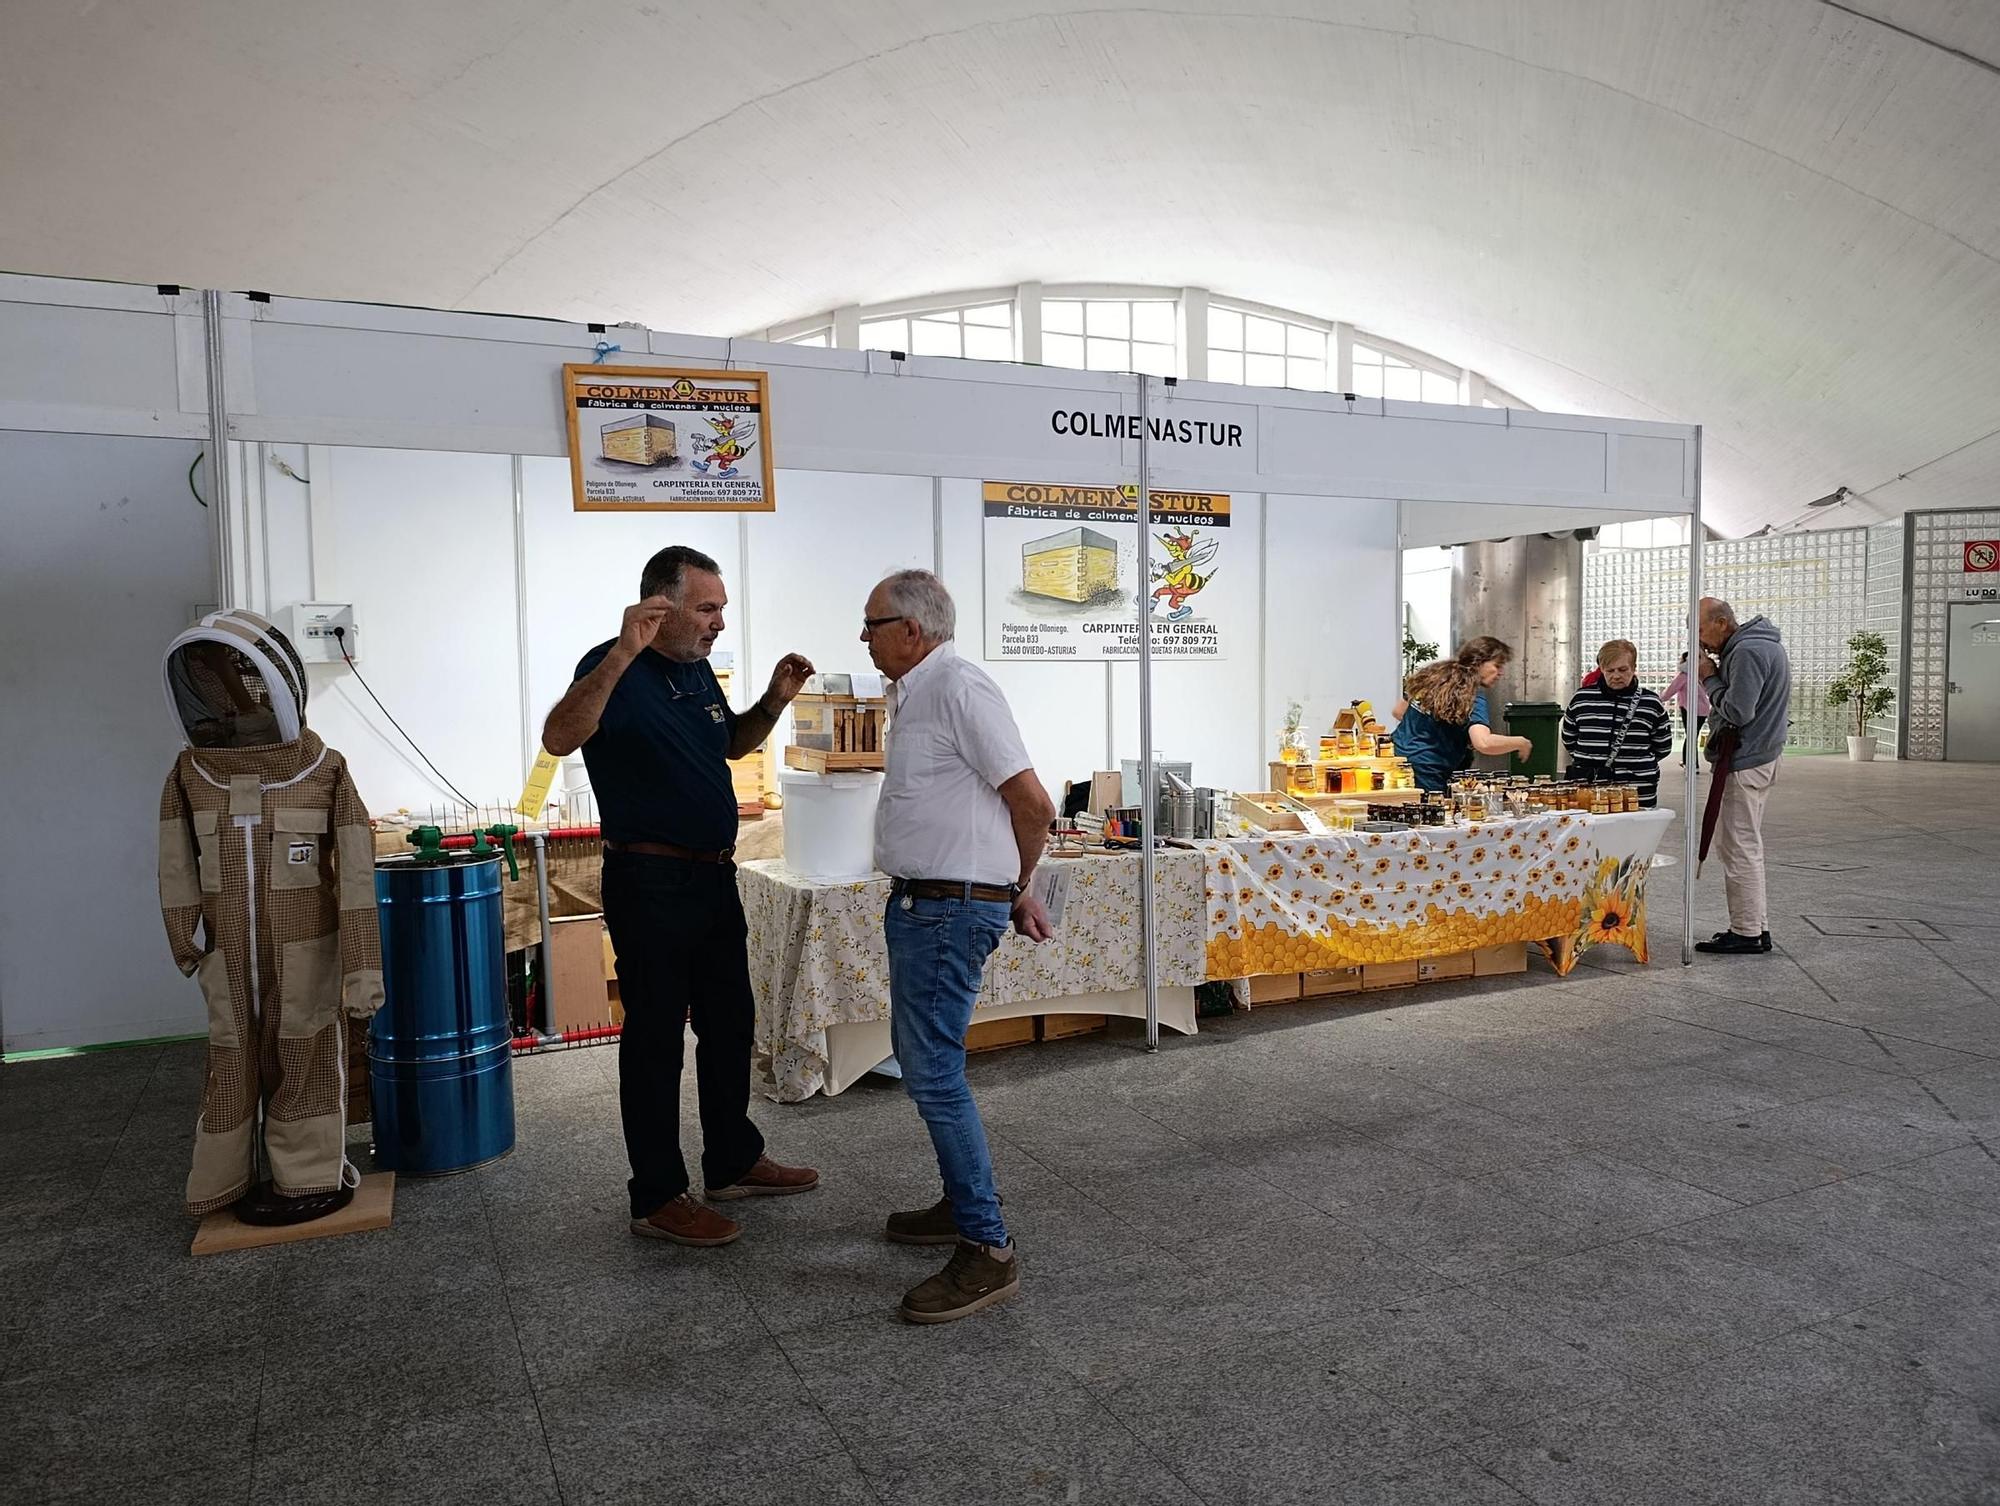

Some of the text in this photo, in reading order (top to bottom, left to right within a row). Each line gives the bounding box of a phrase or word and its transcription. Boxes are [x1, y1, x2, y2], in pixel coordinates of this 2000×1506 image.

[633, 401, 645, 409] de
[651, 402, 697, 410] colmenas
[1051, 410, 1243, 448] COLMENASTUR
[711, 480, 723, 488] EN
[724, 480, 761, 489] GENERAL
[682, 488, 716, 496] Teléfono:
[1065, 509, 1081, 519] de
[1088, 510, 1138, 521] colmena
[1153, 514, 1161, 523] y
[1167, 514, 1214, 525] nucleos
[1030, 623, 1038, 633] de
[1082, 623, 1218, 635] CARPINTERA EN GENERAL
[1002, 634, 1039, 644] Parcela B33
[1163, 635, 1179, 645] 697
[1182, 635, 1198, 645] 809
[1201, 635, 1218, 645] 771
[1001, 645, 1077, 655] 33660 OVIEDO-ASTURIAS
[1173, 646, 1188, 655] PARA
[1189, 646, 1218, 655] CHIMENEA
